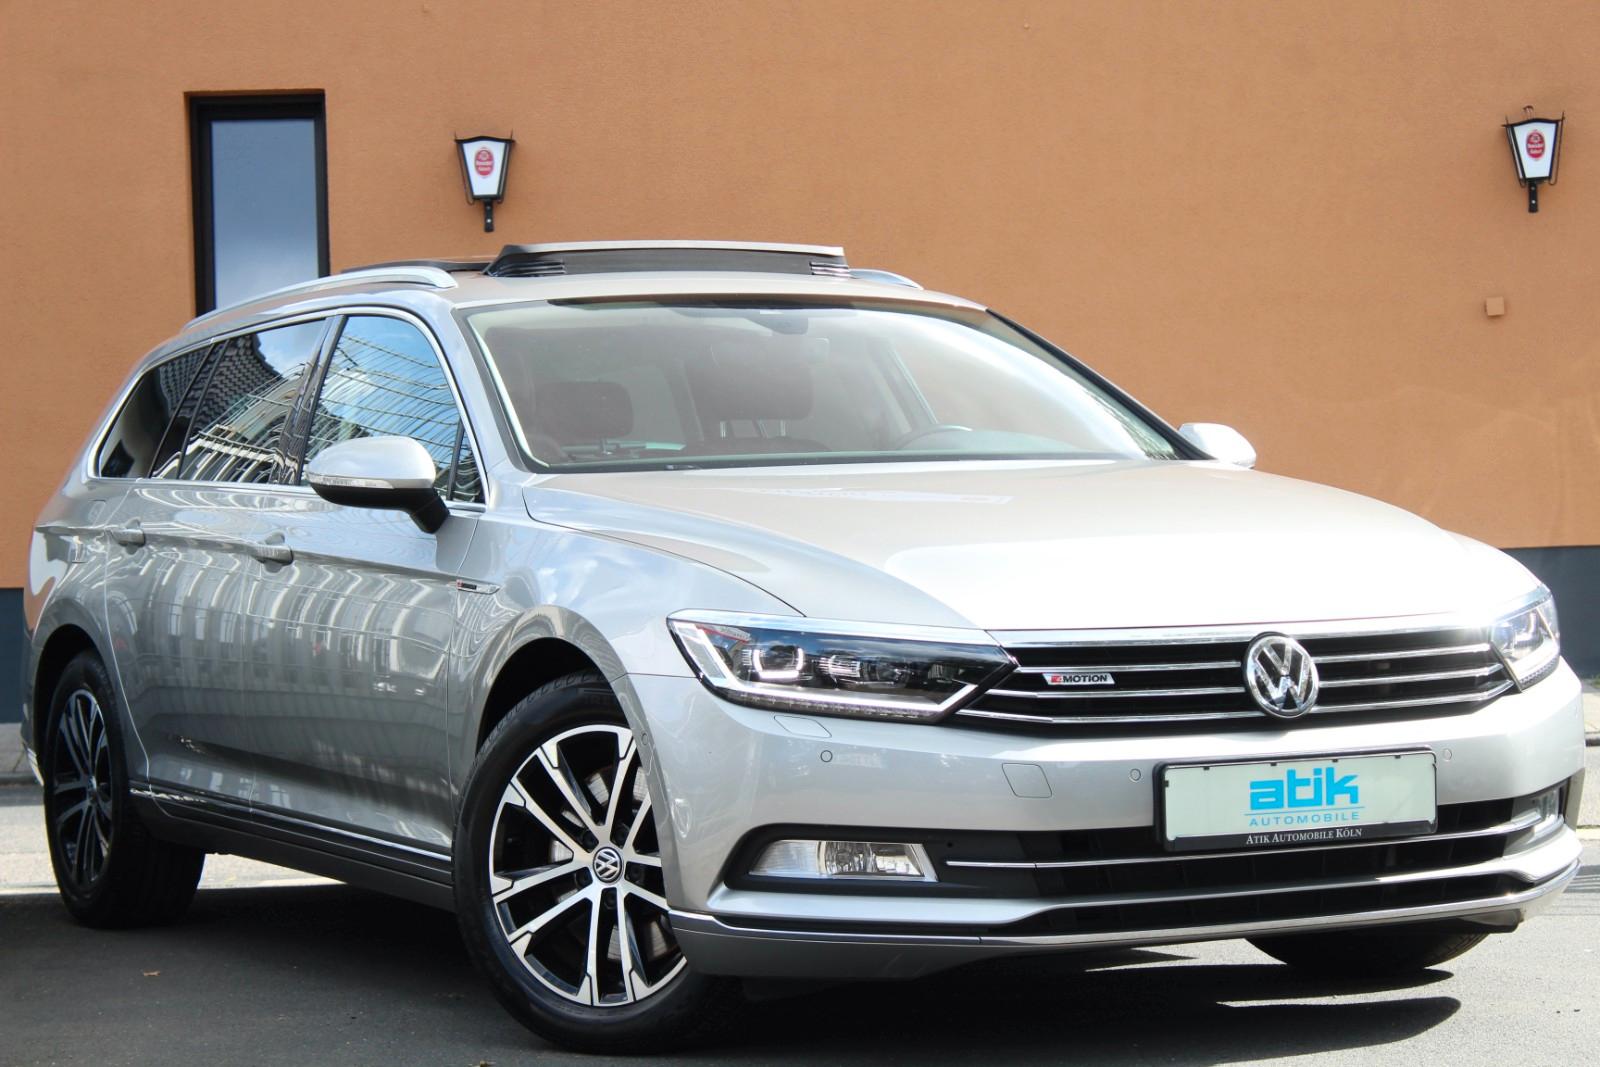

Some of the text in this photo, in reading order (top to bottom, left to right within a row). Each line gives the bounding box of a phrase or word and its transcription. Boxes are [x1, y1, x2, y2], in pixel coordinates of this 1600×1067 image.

[1250, 767, 1359, 809] atik
[1249, 812, 1360, 826] AUTOMOBILE
[1246, 827, 1362, 845] ATIK AUTOMOBILE KÖLN
